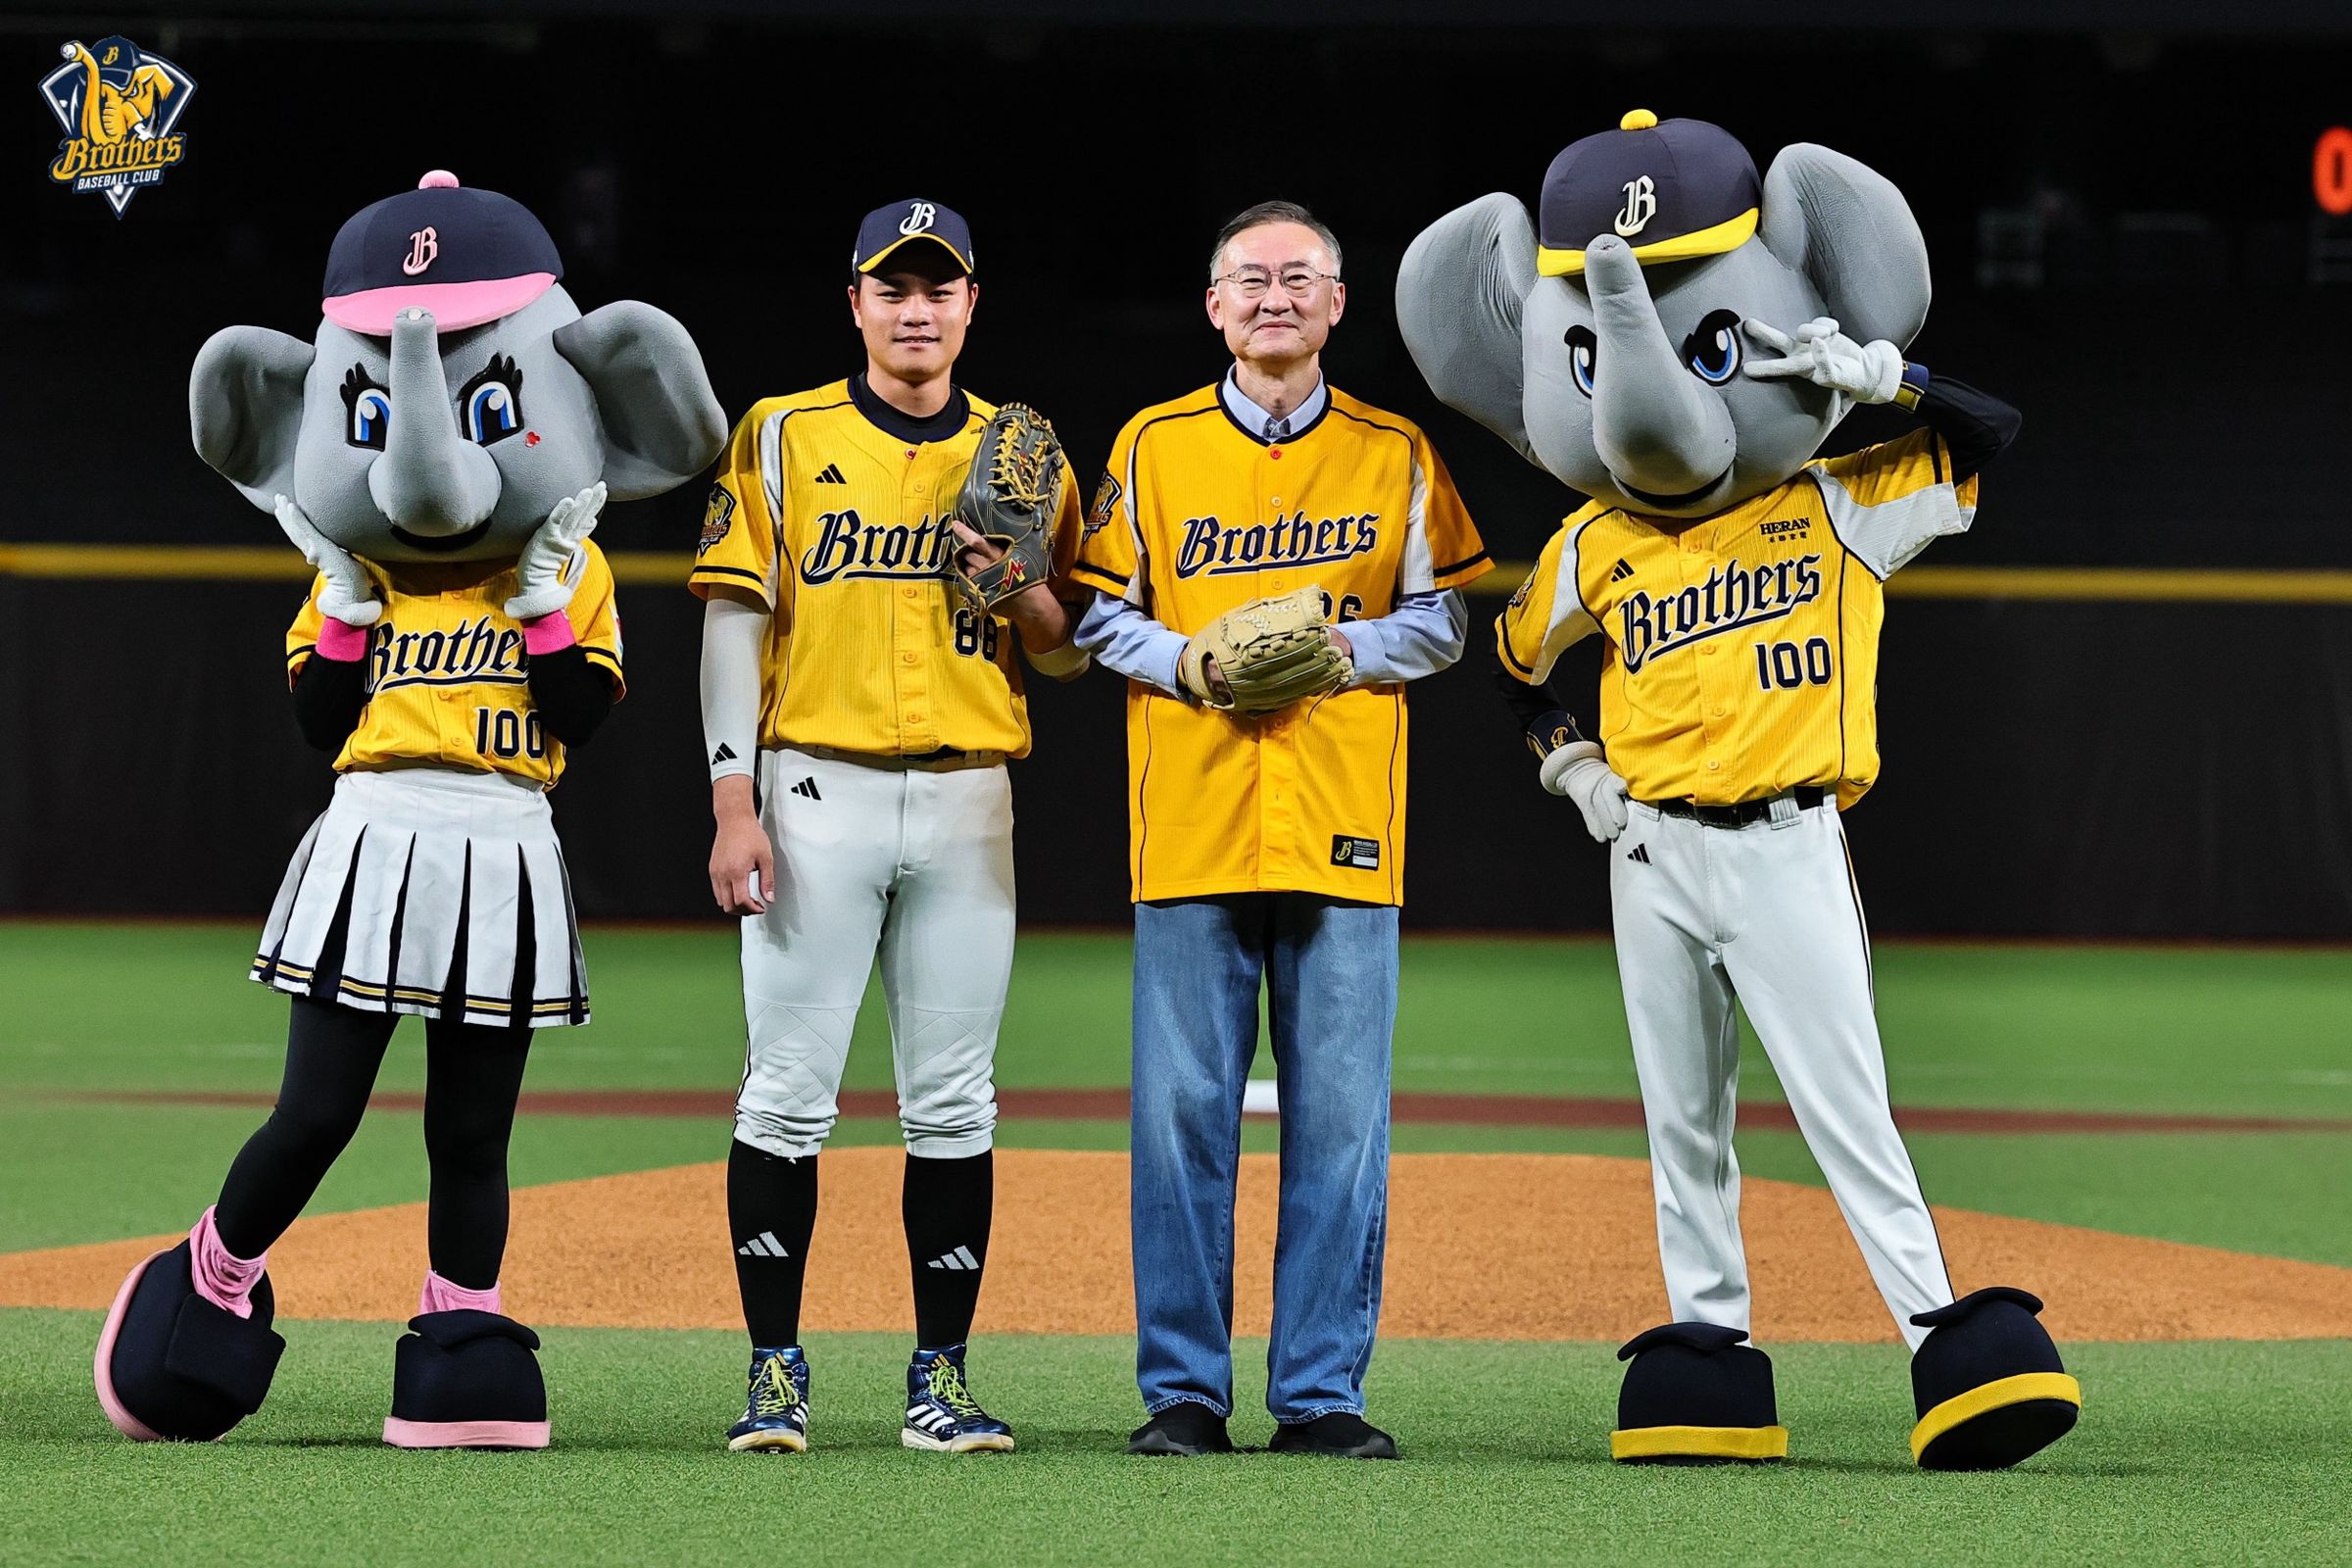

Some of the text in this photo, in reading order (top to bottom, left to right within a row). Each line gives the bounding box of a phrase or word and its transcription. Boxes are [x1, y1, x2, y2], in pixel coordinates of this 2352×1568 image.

[899, 202, 936, 235] B
[1614, 174, 1656, 236] B
[403, 226, 438, 275] B
[1176, 510, 1381, 580] Brothers
[1759, 516, 1811, 535] HERAN
[953, 608, 999, 663] 88
[1618, 552, 1823, 676] Brothers
[1754, 636, 1833, 692] 100
[475, 707, 547, 760] 100
[1335, 841, 1352, 861] B
